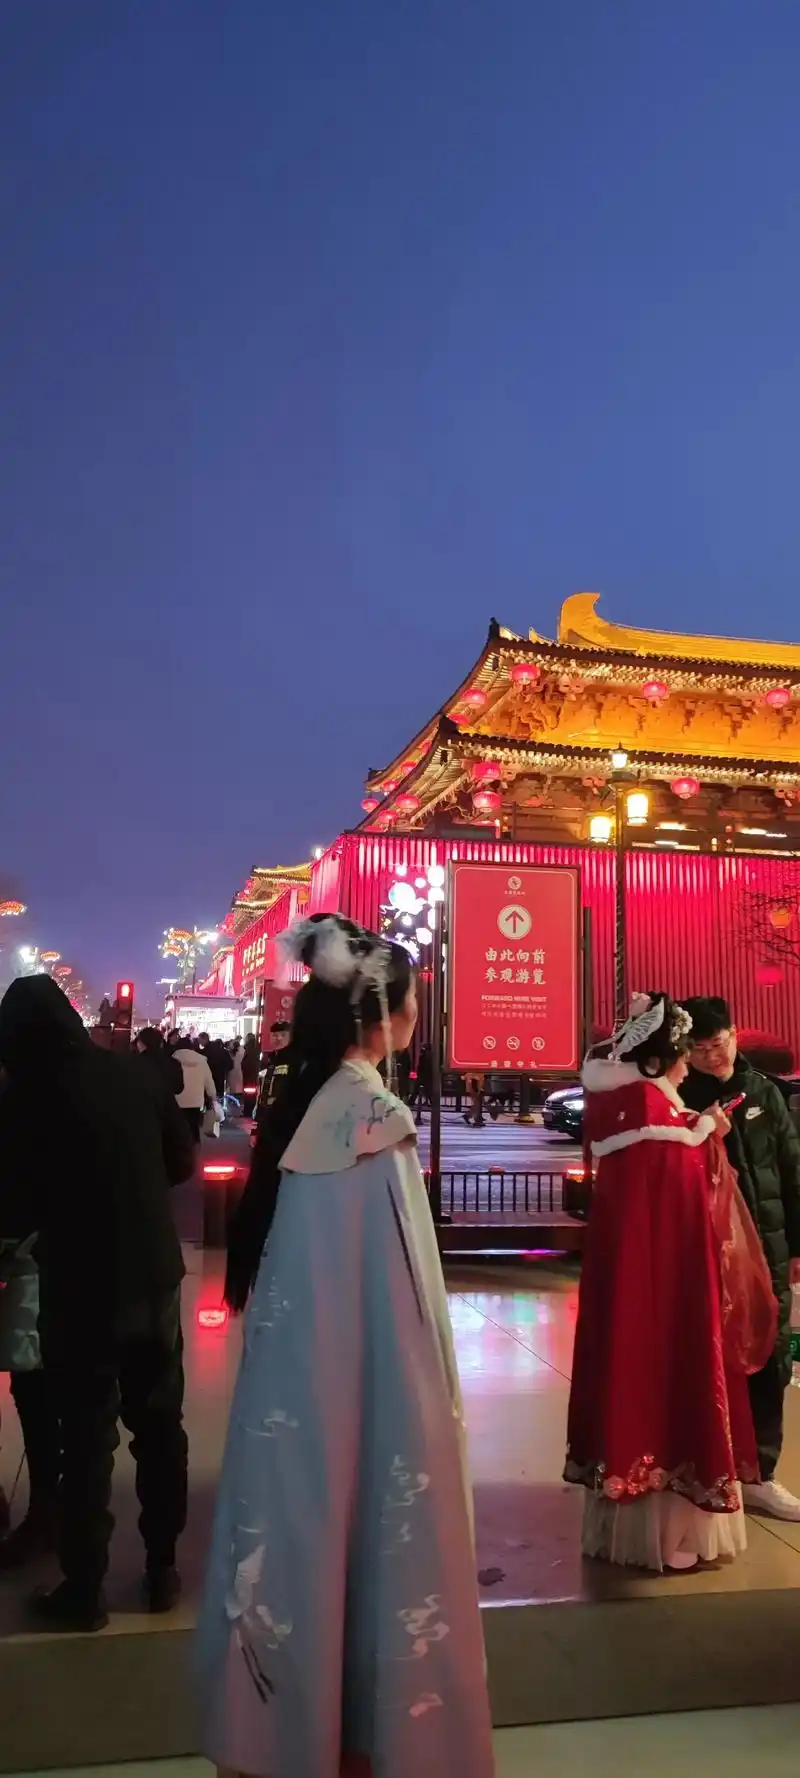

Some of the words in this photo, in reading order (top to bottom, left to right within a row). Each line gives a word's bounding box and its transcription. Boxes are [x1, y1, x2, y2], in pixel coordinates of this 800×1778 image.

[485, 947, 546, 965] 由此向前
[483, 966, 547, 985] 参观游览
